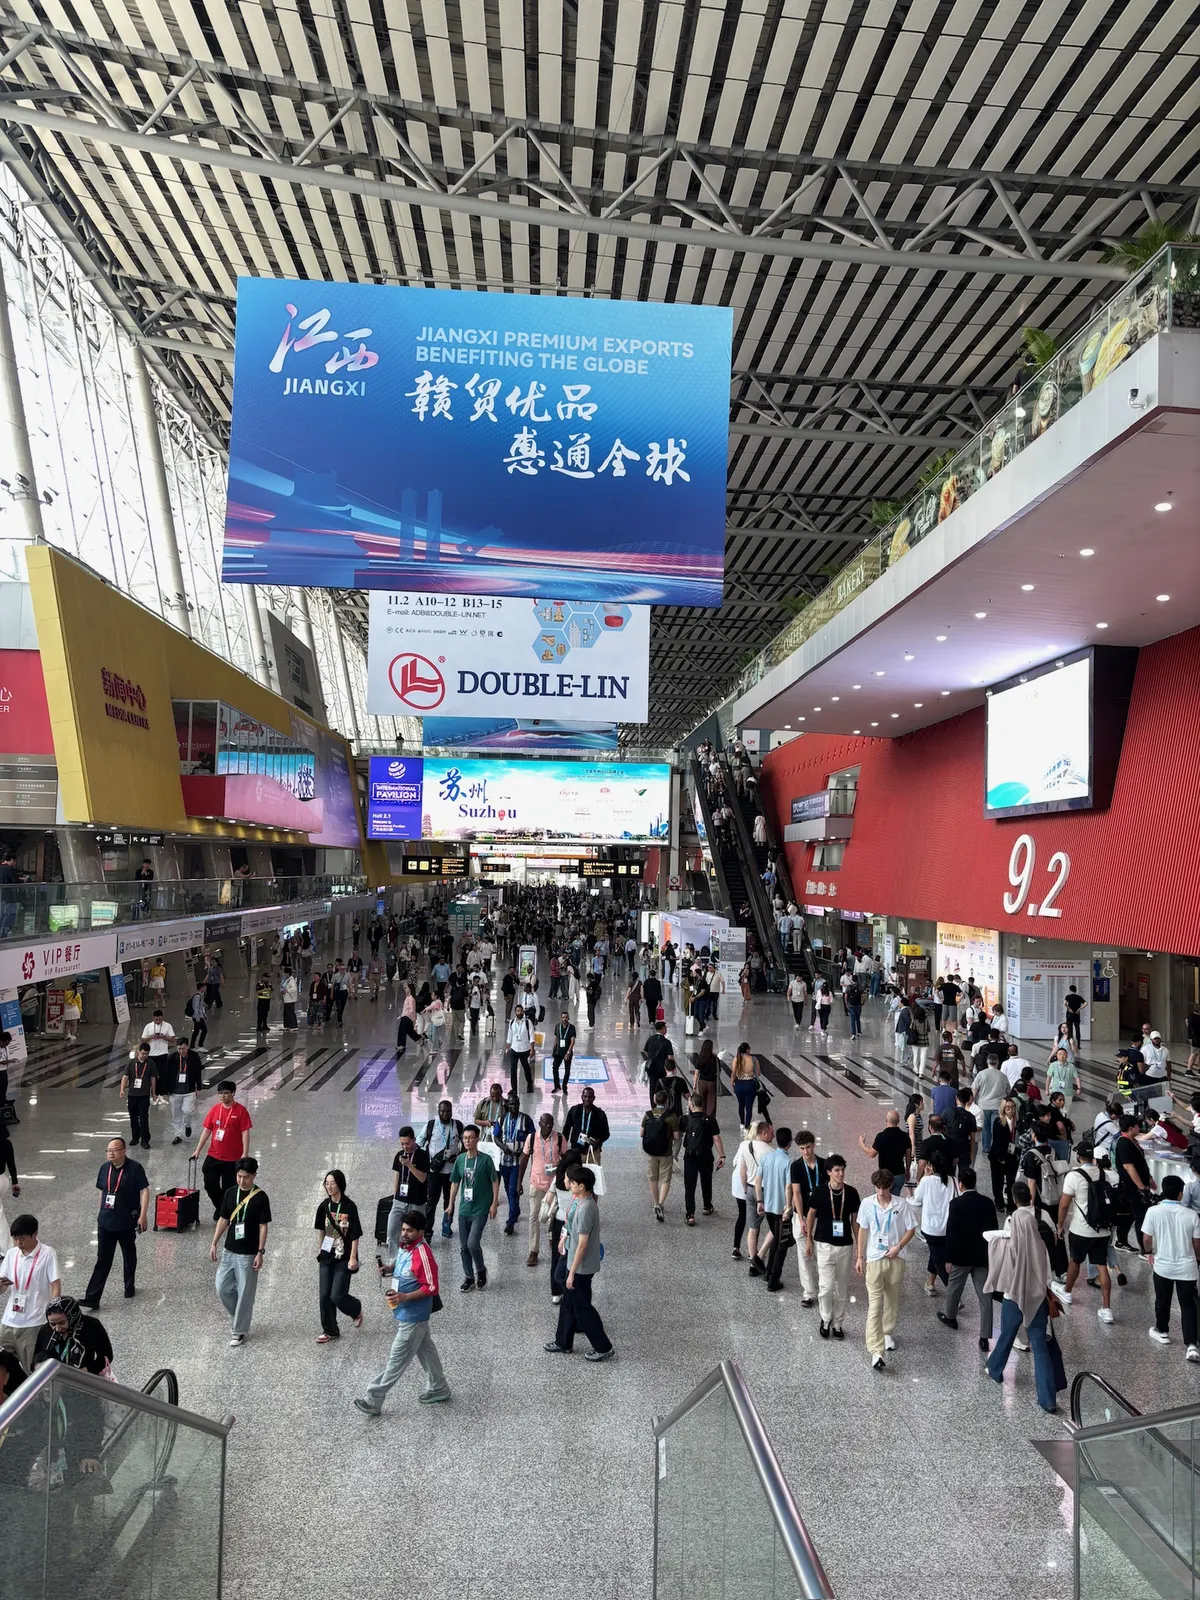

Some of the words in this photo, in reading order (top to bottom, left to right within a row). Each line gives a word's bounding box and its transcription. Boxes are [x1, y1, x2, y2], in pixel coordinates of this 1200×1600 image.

[268, 303, 379, 375] 江西
[416, 326, 498, 346] JIANGXI
[504, 331, 598, 352] PREMIUM
[603, 337, 695, 359] EXPORTS
[416, 346, 533, 368] BENEFITING
[538, 353, 578, 369] THE
[581, 355, 649, 375] GLOBE
[283, 377, 366, 397] JIANGXI
[404, 370, 599, 423] 赣贸优品
[503, 425, 692, 486] 惠通全球
[387, 595, 409, 605] 11.2
[457, 670, 629, 700] DOUBLE-LIN
[376, 791, 417, 799] PAVILION
[439, 768, 488, 803] 苏州
[1003, 833, 1071, 919] 9.2
[43, 947, 62, 966] VIP
[64, 943, 81, 963] 餐厅
[55, 963, 81, 975] Restaurant
